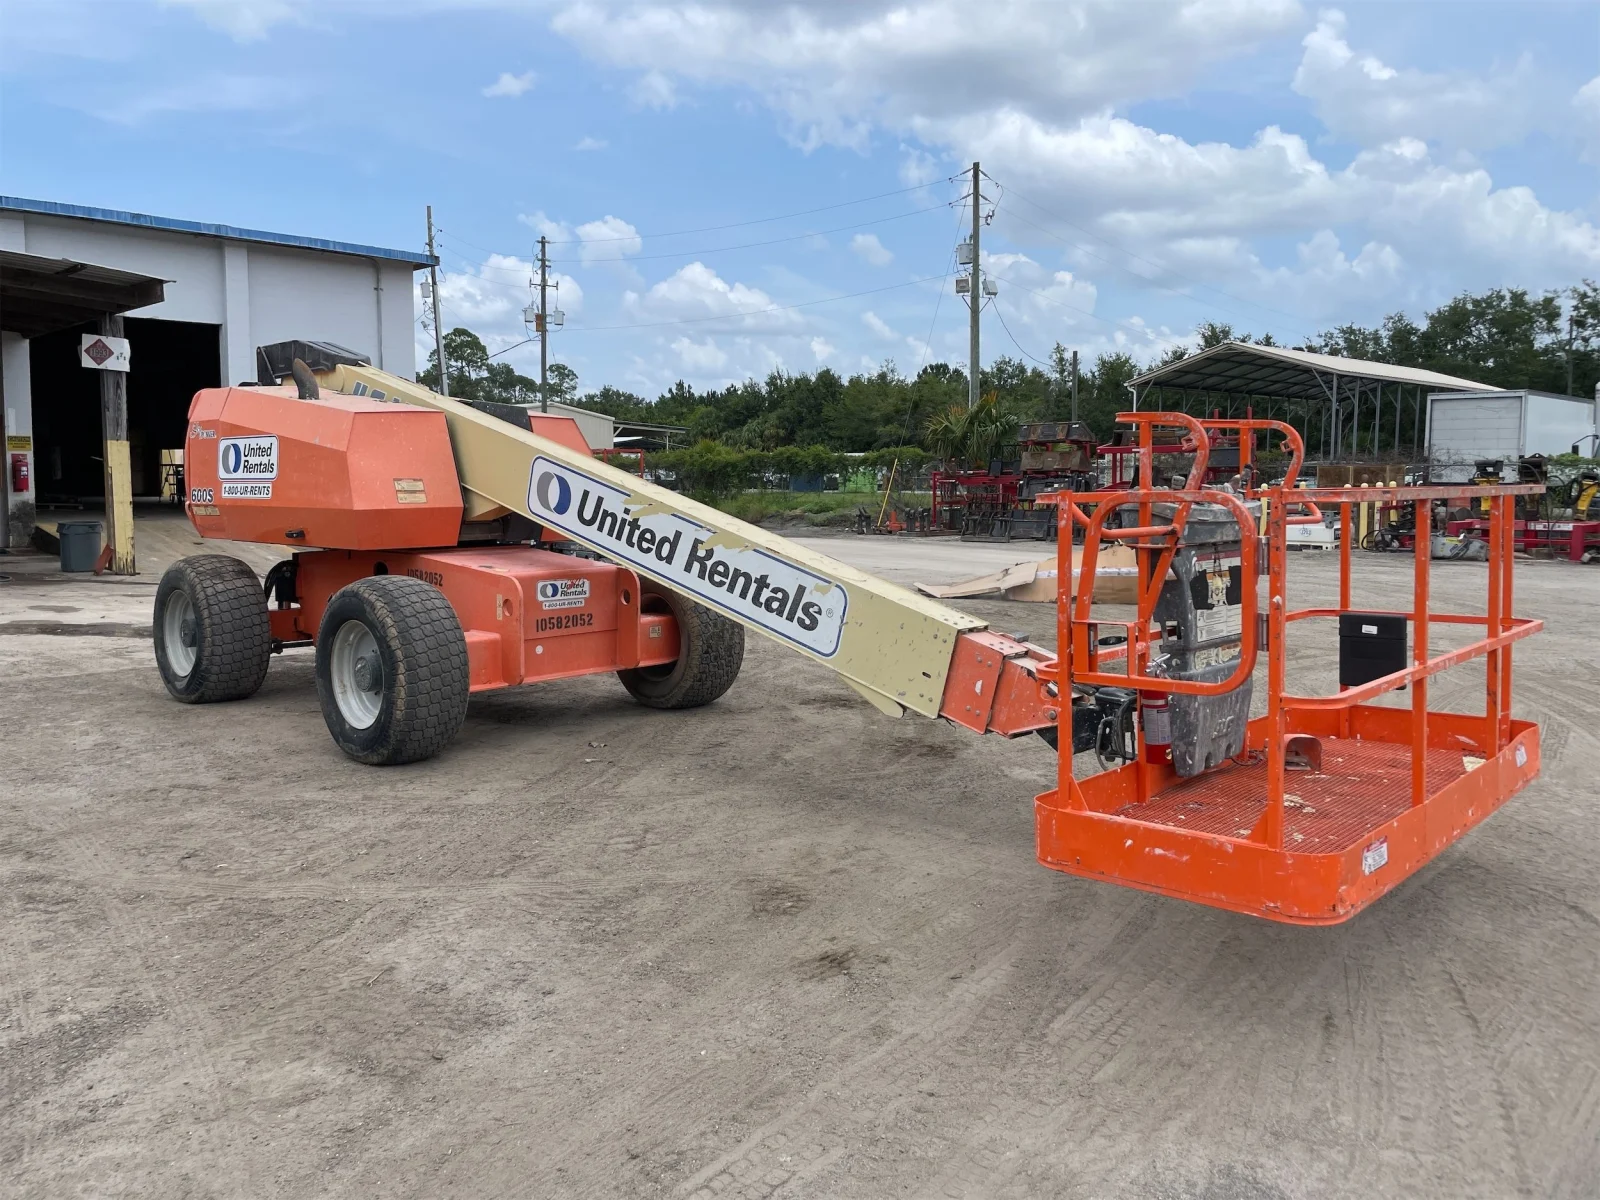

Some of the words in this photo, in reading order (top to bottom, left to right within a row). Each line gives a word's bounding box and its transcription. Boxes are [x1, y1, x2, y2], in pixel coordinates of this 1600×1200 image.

[91, 348, 108, 358] 1993
[243, 443, 273, 457] United
[242, 459, 275, 474] Rentals
[191, 489, 214, 503] 600S
[223, 486, 270, 496] 1-800-UR-RENTS
[577, 489, 682, 565] United
[683, 538, 822, 632] Rentals
[560, 587, 587, 597] Rentals
[536, 613, 593, 632] 10582052
